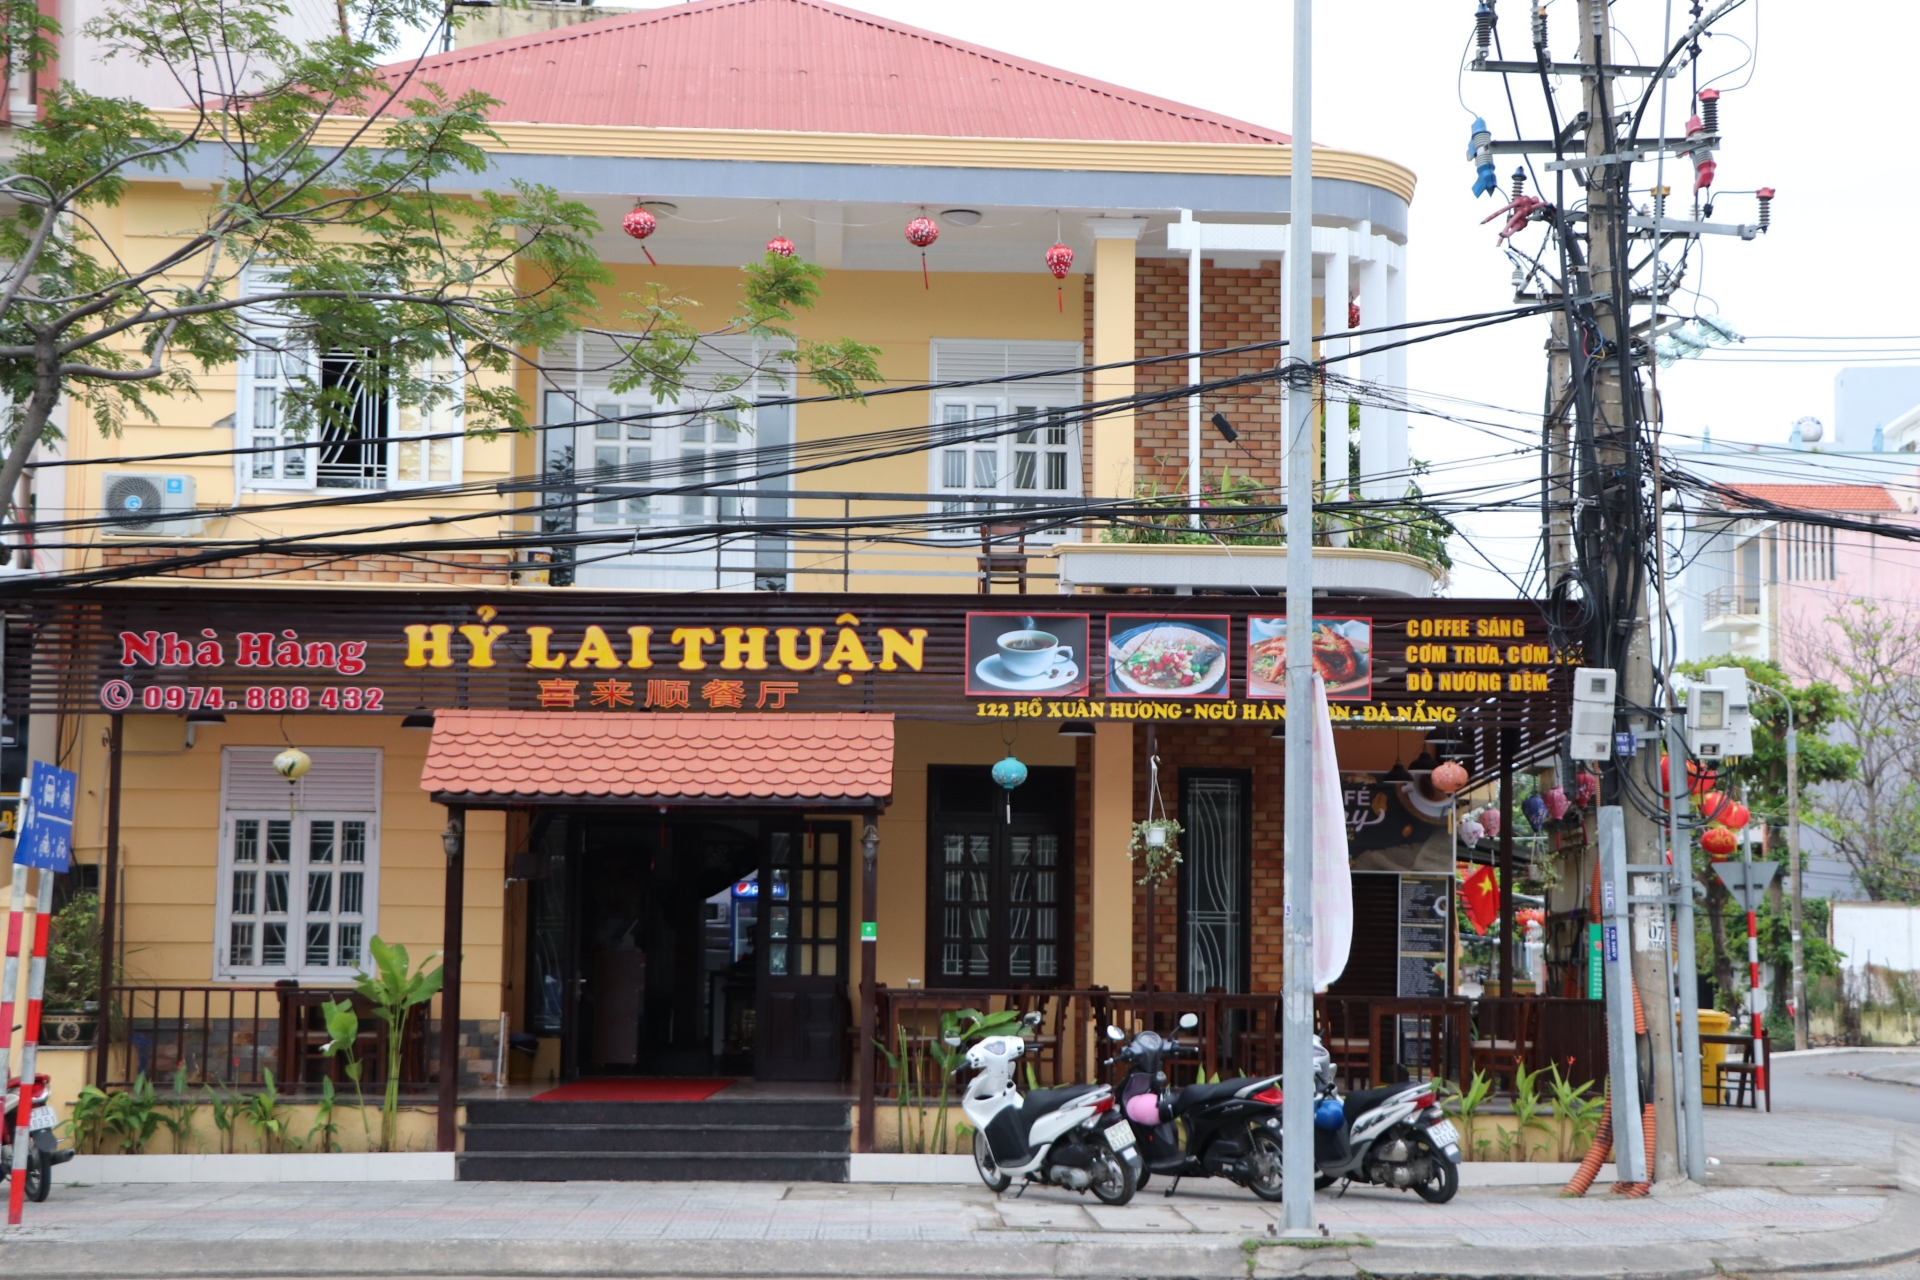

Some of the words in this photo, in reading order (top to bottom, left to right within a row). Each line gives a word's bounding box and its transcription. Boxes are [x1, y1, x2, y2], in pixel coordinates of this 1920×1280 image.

[1406, 619, 1470, 638] COFFEE
[1477, 616, 1525, 638] SÁNG
[119, 628, 225, 667] Nhà
[236, 629, 368, 676] Hàng
[403, 604, 510, 669] HỶ
[526, 624, 654, 670] LAI
[670, 612, 929, 686] THUẬN
[1405, 642, 1447, 664] CƠM
[1453, 643, 1504, 666] TRƯA,
[1507, 642, 1549, 664] CƠM
[536, 677, 800, 709] 喜来顺餐厅
[1439, 671, 1501, 692] NƯỚNG
[1508, 669, 1549, 692] ĐÊM
[318, 687, 384, 711] 432
[977, 702, 1010, 718] 122
[1013, 697, 1043, 718] HỒ
[1046, 698, 1106, 718] XUÂN
[1109, 700, 1183, 720] HƯƠNG
[1194, 699, 1238, 720] NGŨ
[1242, 700, 1286, 720] HÀN
[1362, 701, 1393, 722] ĐÀ
[1396, 699, 1457, 723] NẴNG
